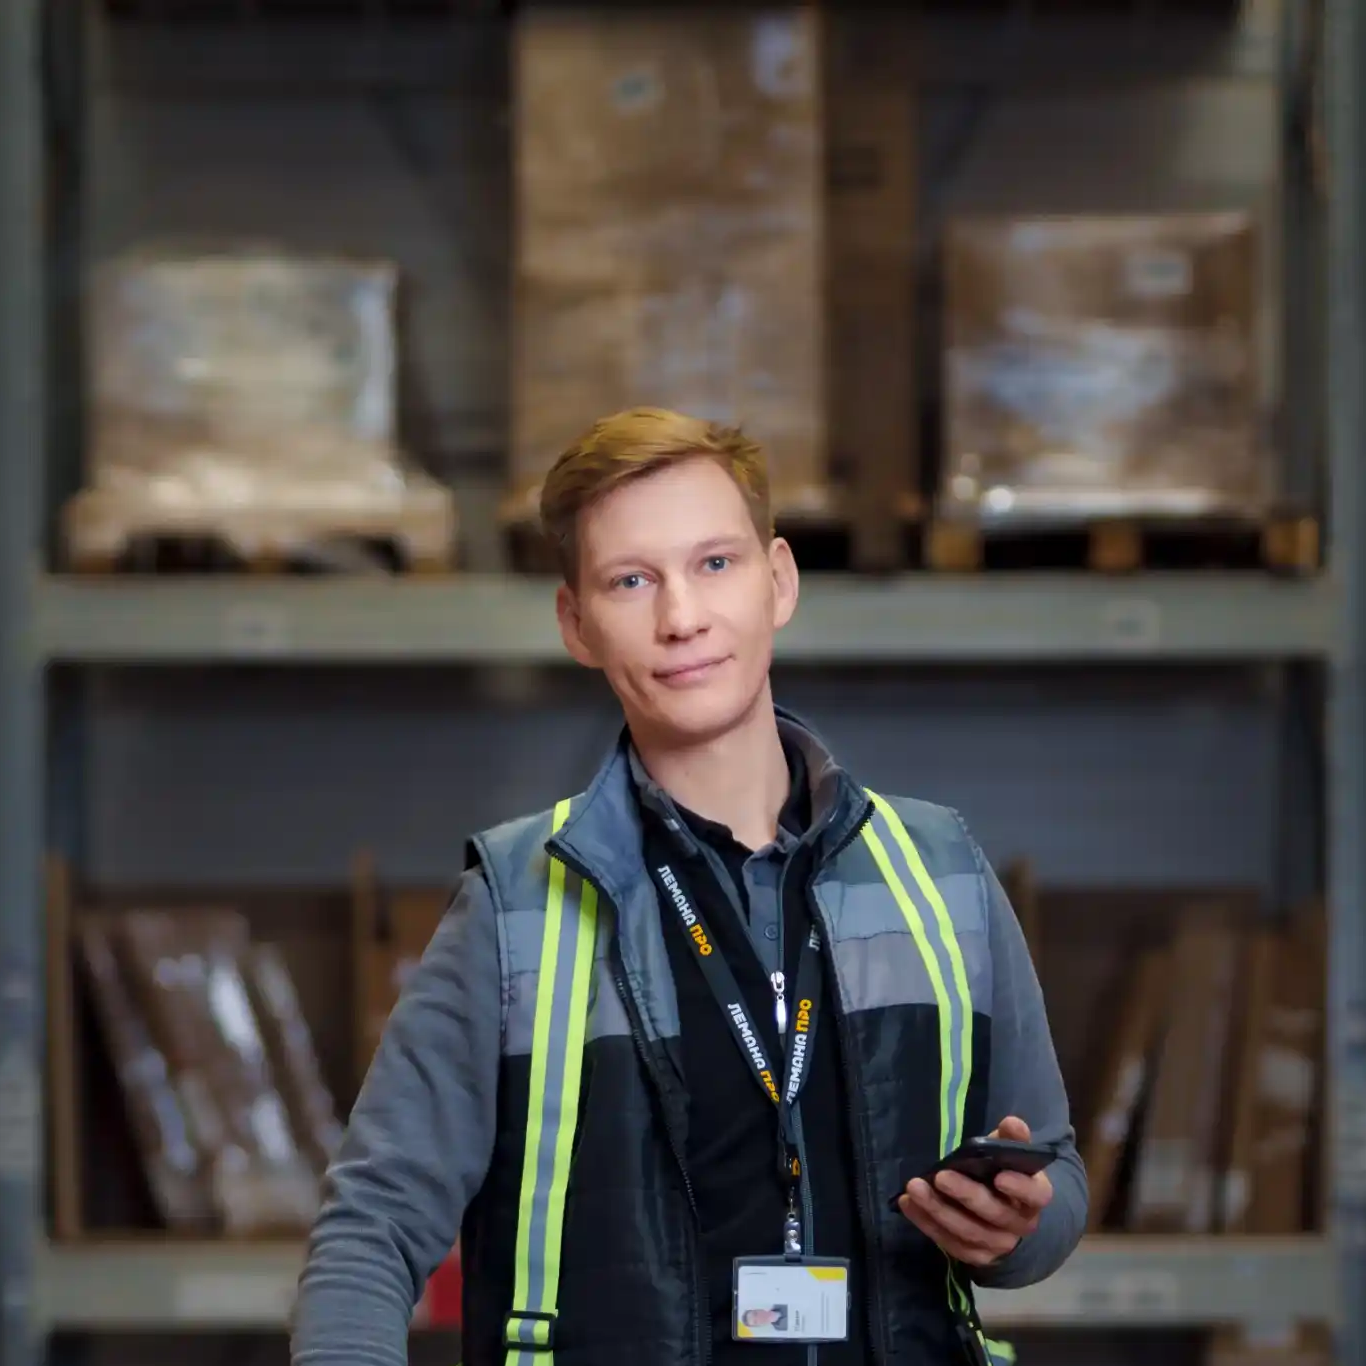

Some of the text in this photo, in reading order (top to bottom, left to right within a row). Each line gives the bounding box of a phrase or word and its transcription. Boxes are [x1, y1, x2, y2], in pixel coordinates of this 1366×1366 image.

[658, 865, 712, 956] ЛЕМАНА ПРО
[728, 1003, 780, 1103] ЛЕМАНА ПРО
[786, 999, 813, 1105] ЛЕМАНА ПРО
